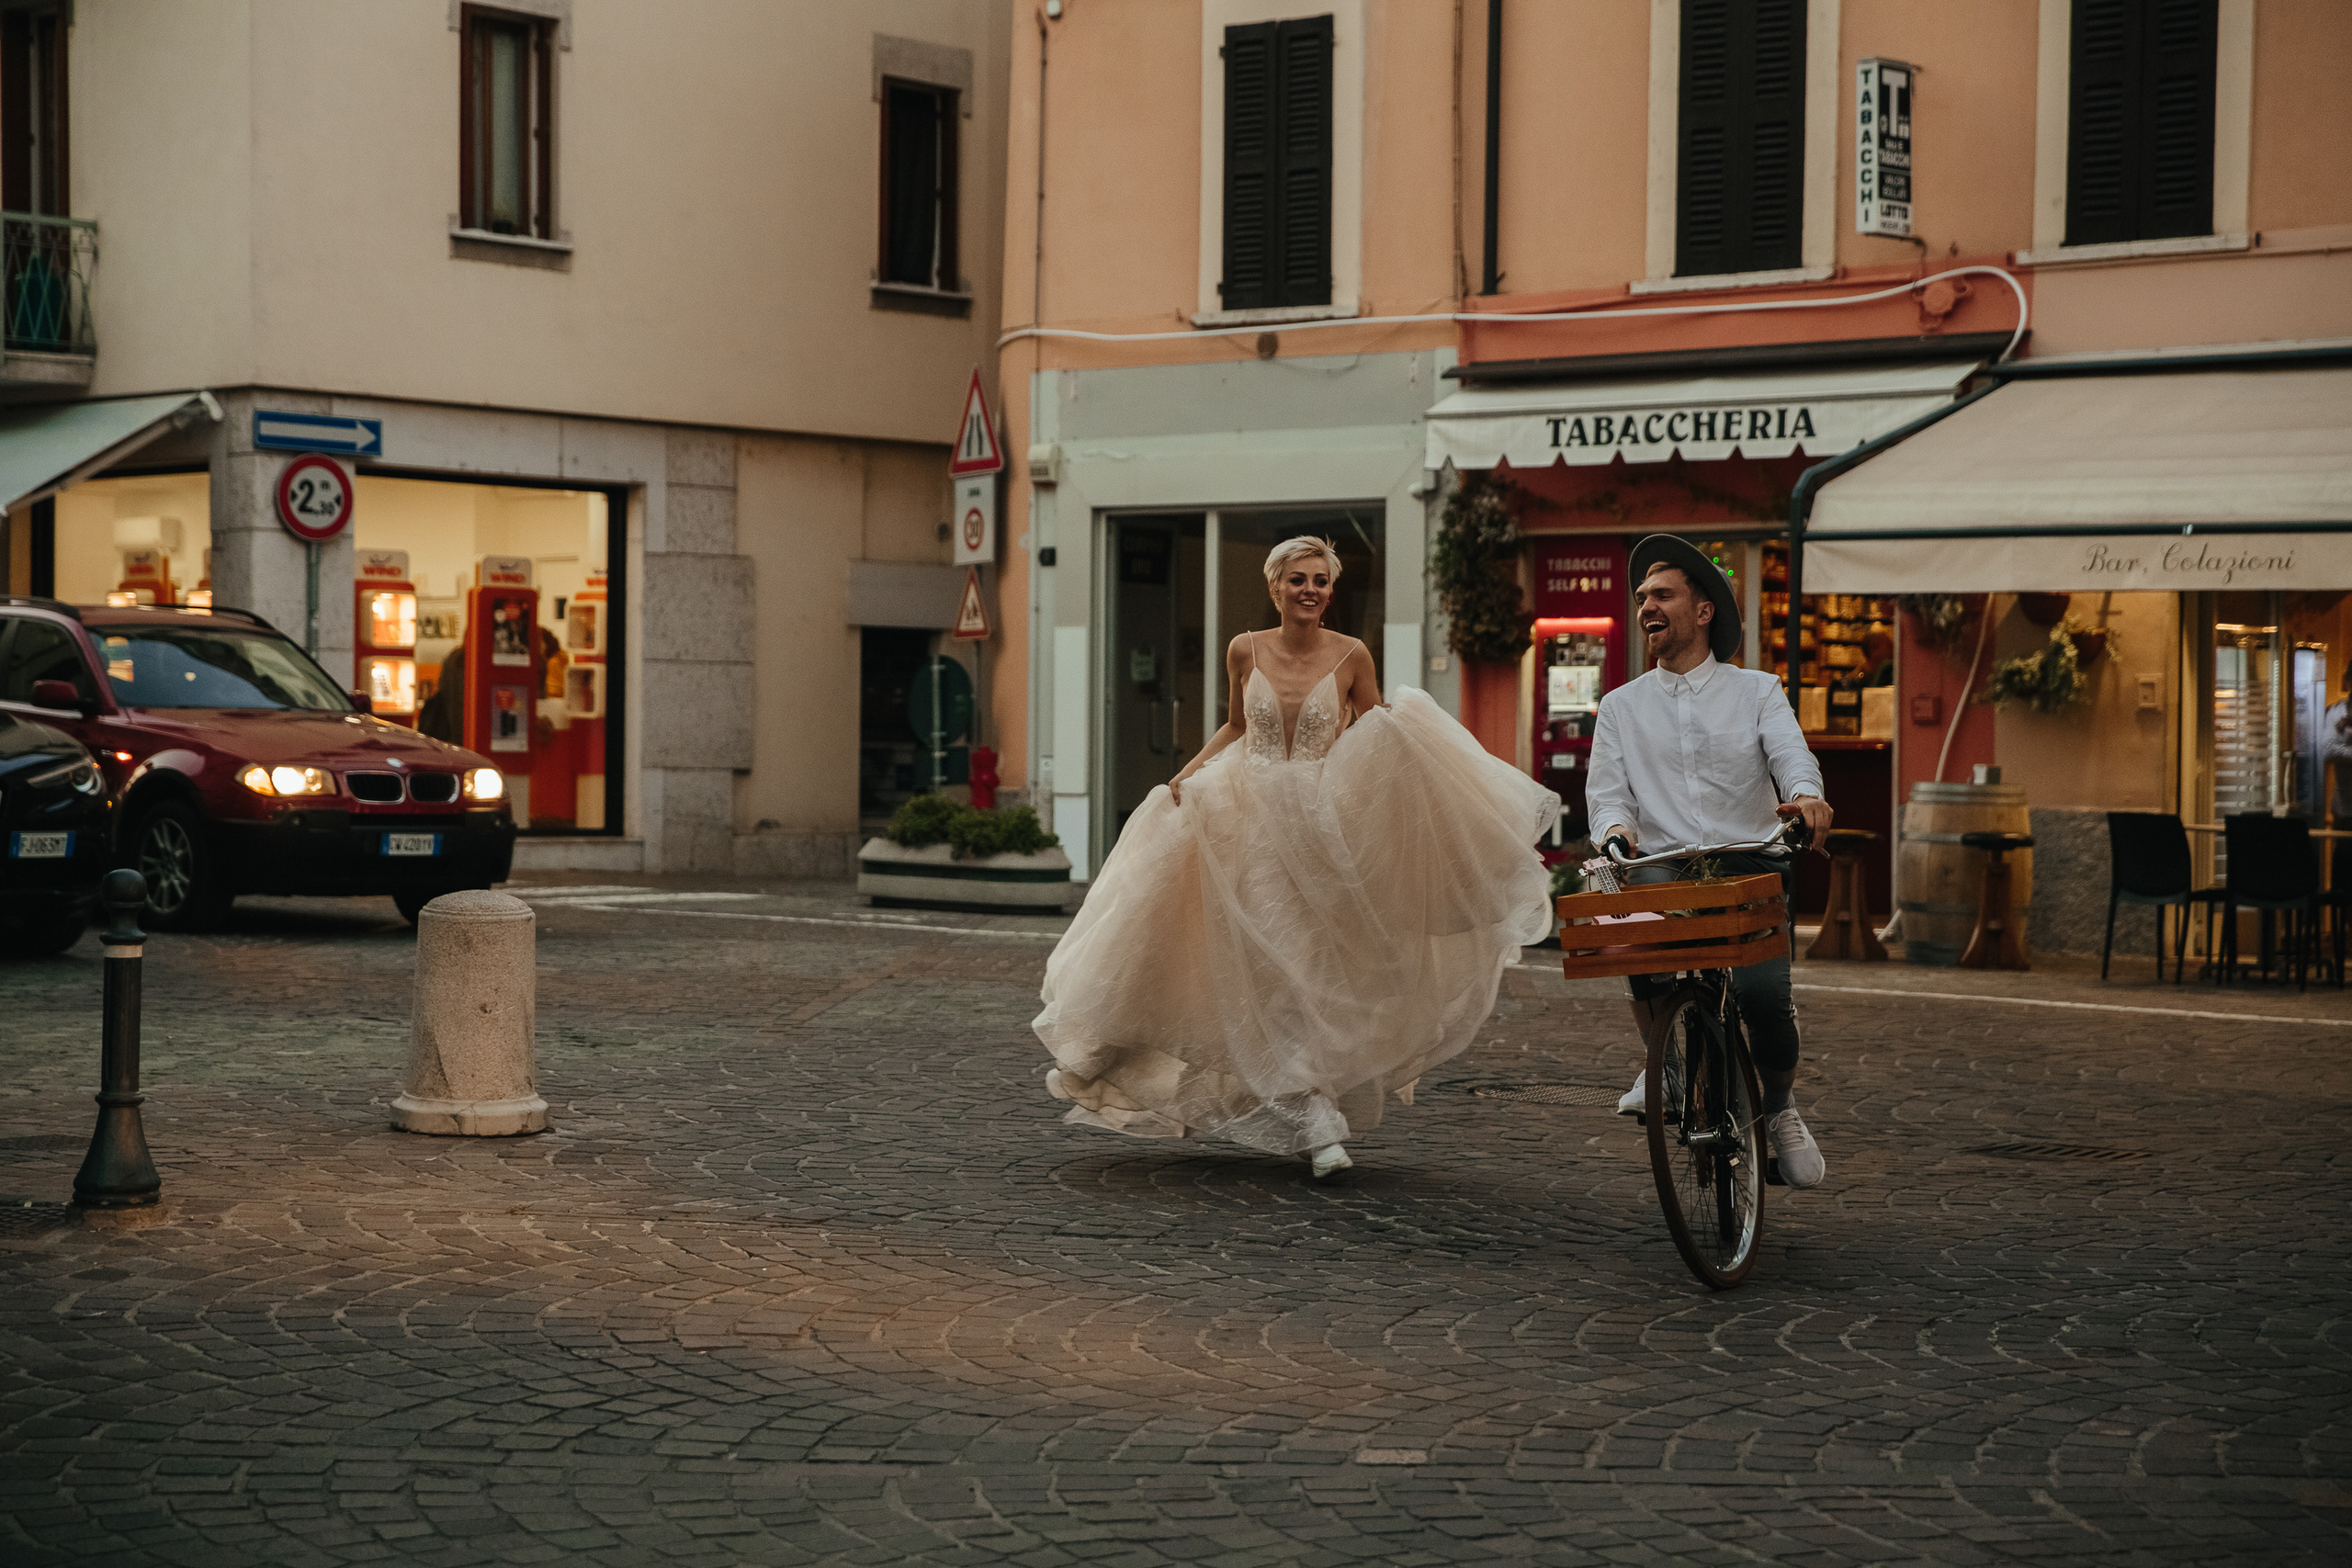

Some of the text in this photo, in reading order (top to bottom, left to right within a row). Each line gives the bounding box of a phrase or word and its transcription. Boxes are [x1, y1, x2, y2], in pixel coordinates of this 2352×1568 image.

[1860, 69, 1872, 222] TABACCHI
[1880, 203, 1908, 220] LOTTO
[1546, 408, 1817, 448] TABACCHERIA
[2082, 542, 2296, 586] Bar, Colazioni
